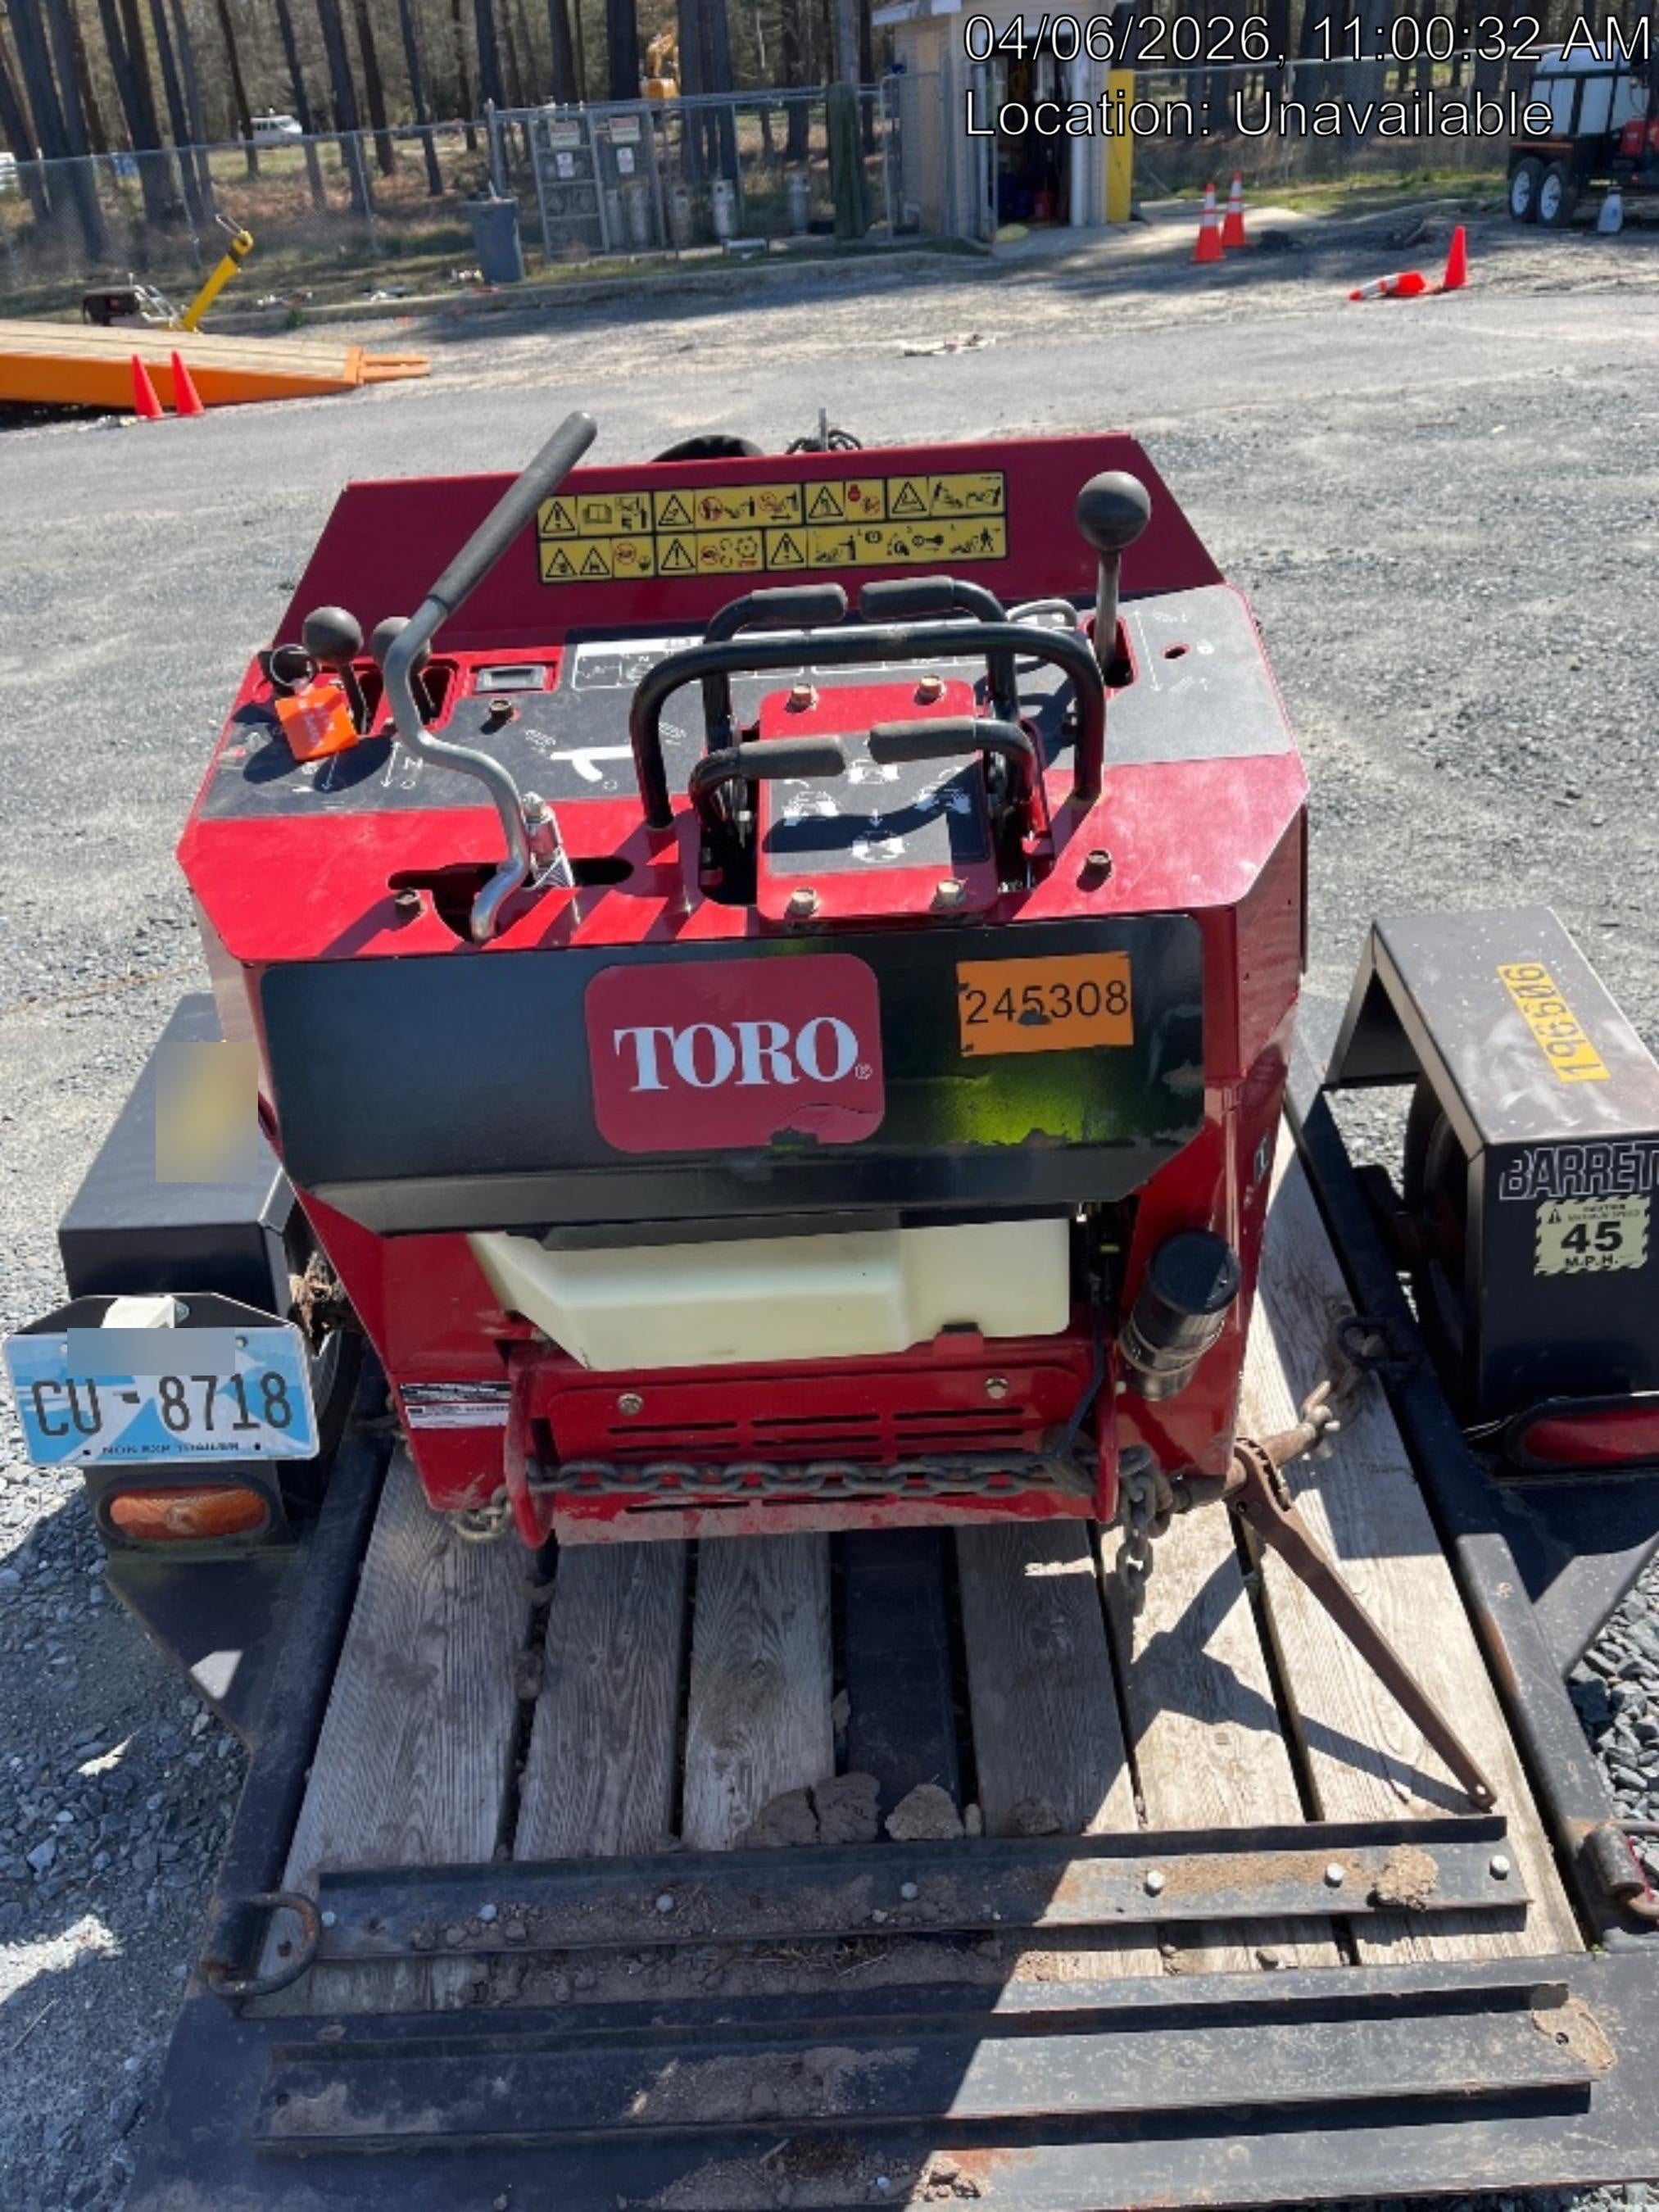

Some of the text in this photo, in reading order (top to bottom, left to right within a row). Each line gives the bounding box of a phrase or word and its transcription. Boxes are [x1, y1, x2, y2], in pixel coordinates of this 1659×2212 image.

[965, 981, 1128, 1024] 245308
[1498, 1140, 1659, 1199] BARRET
[1561, 1221, 1623, 1253] 45
[1566, 1254, 1619, 1267] M.P.H.
